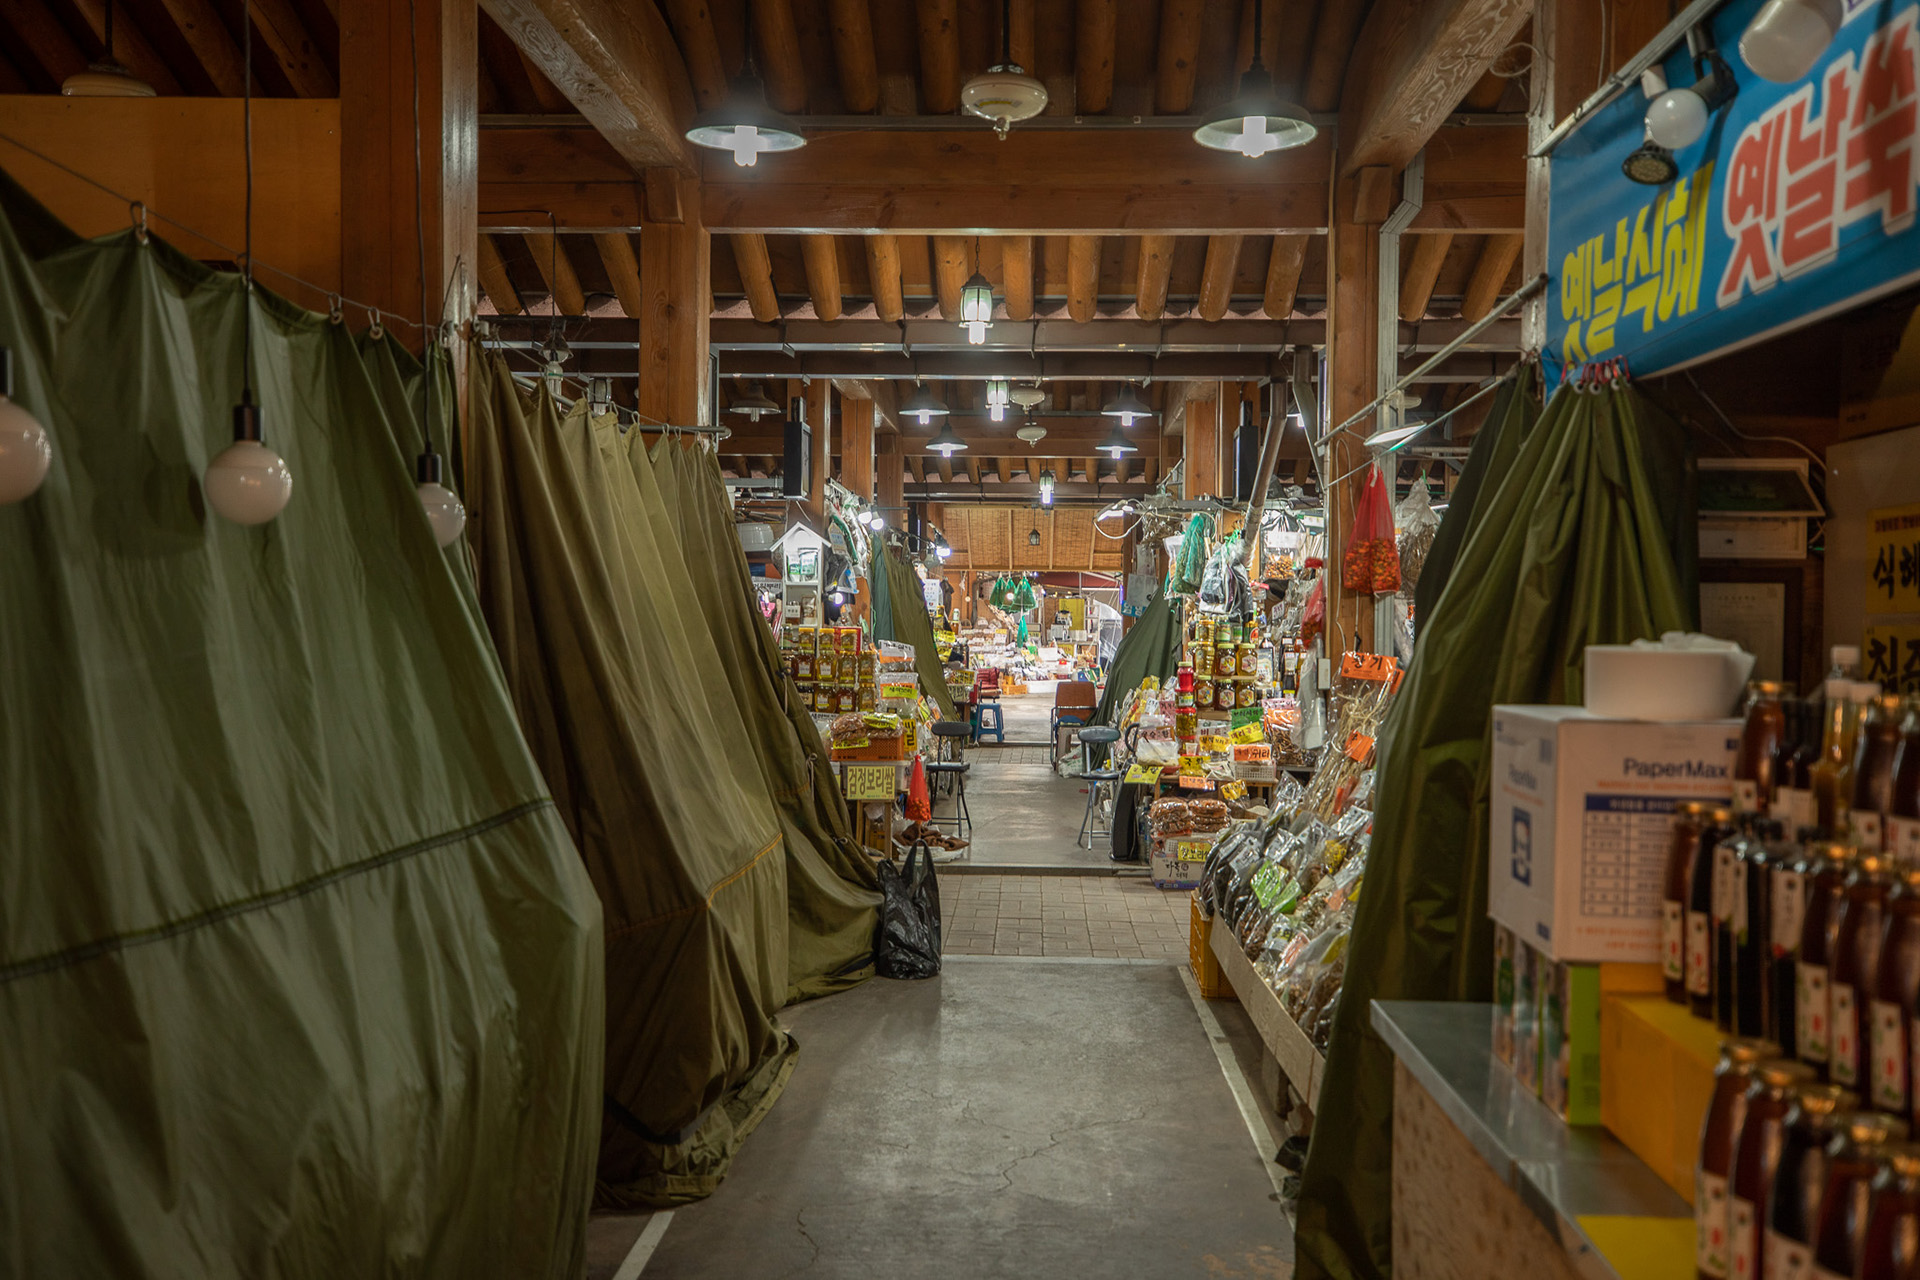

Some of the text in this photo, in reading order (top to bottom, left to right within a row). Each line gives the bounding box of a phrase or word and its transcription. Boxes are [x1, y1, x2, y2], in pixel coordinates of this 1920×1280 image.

[1561, 160, 1715, 370] 옛날식혜
[849, 767, 895, 795] 검정보리쌀
[1623, 757, 1729, 778] PaperMax
